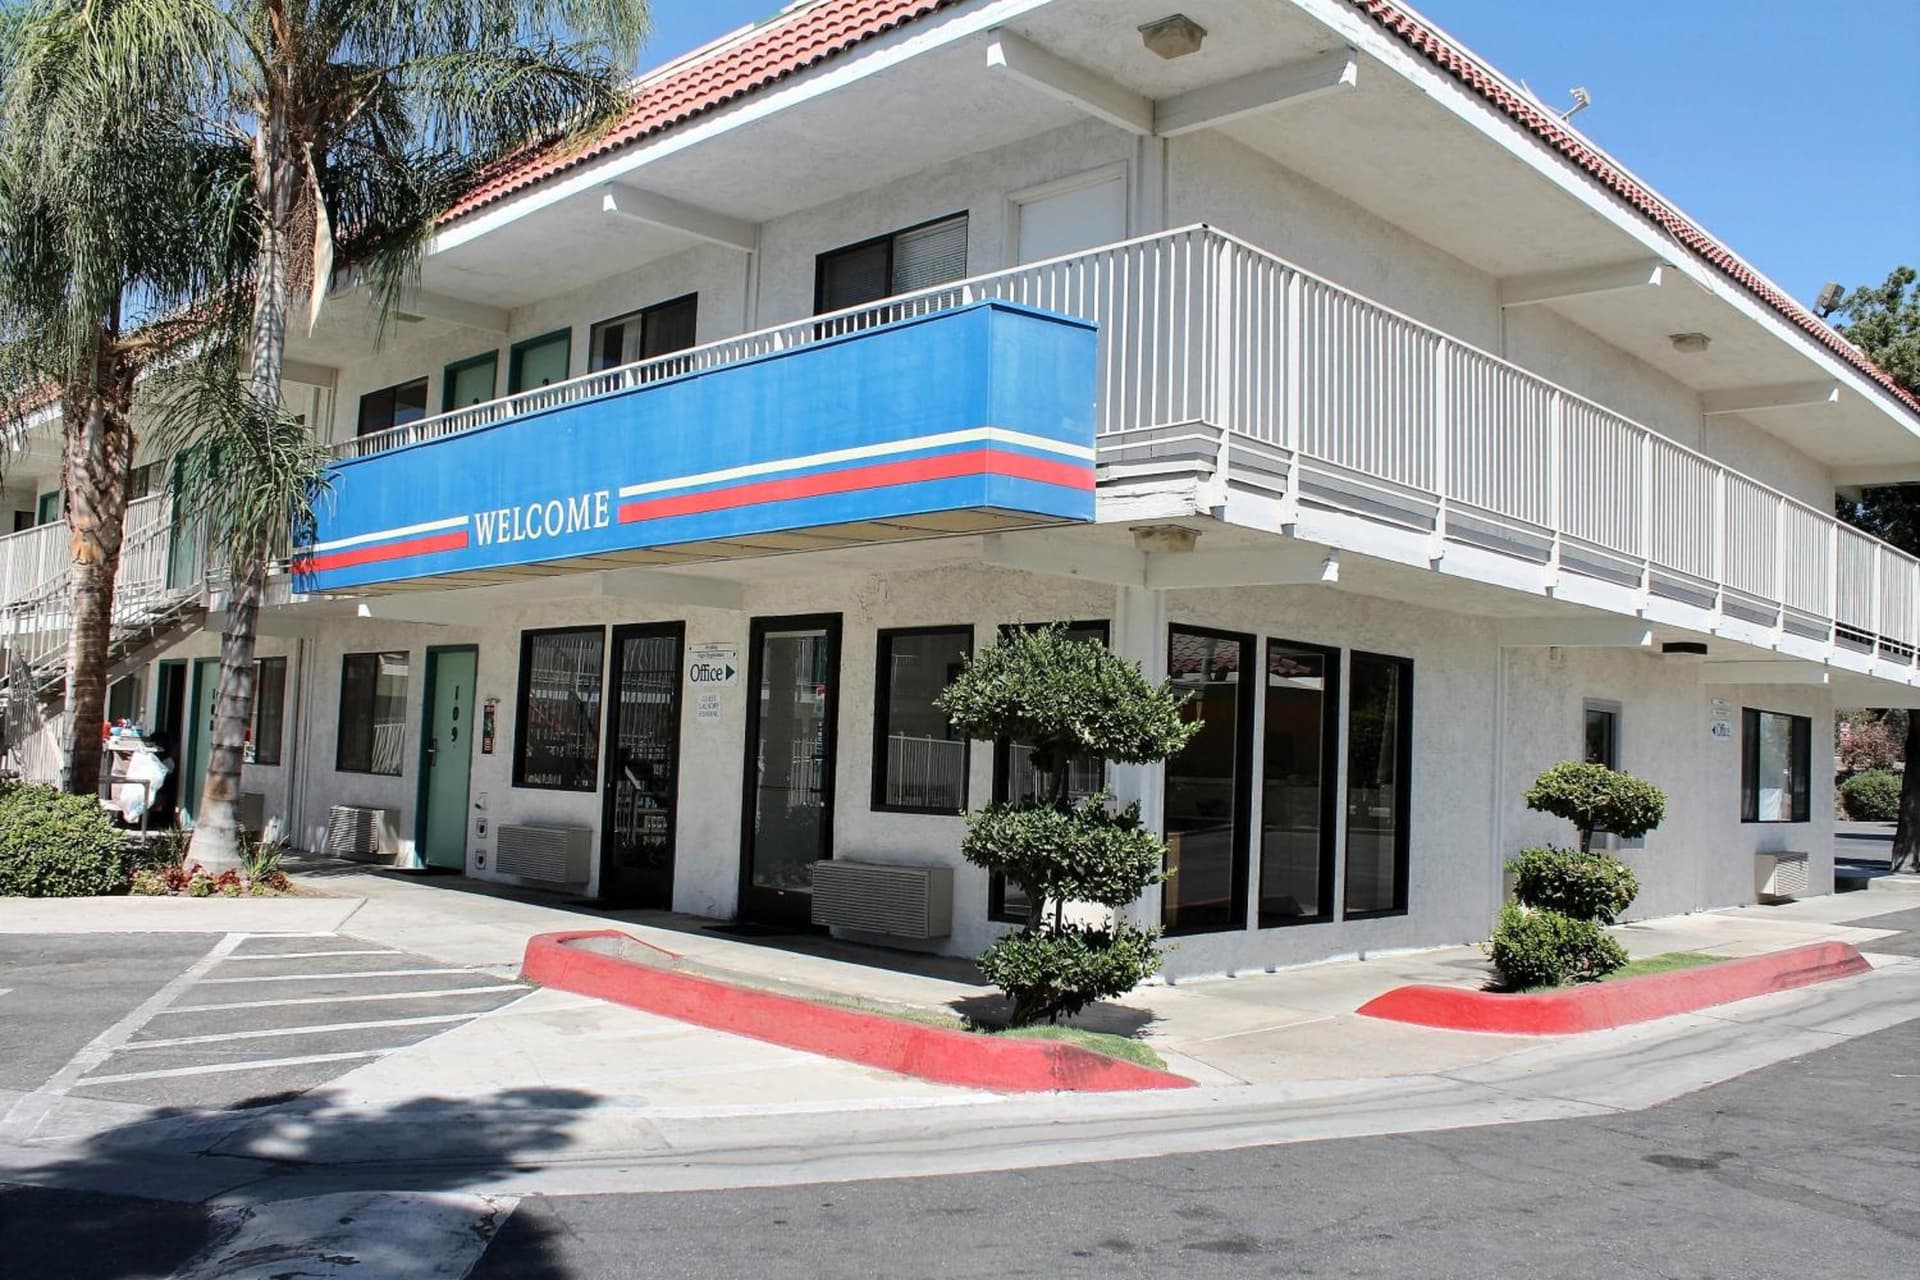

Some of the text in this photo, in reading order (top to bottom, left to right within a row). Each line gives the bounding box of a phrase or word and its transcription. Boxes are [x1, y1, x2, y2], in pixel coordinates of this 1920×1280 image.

[474, 490, 610, 546] WELCOME
[690, 663, 723, 682] Office
[451, 685, 460, 742] 109
